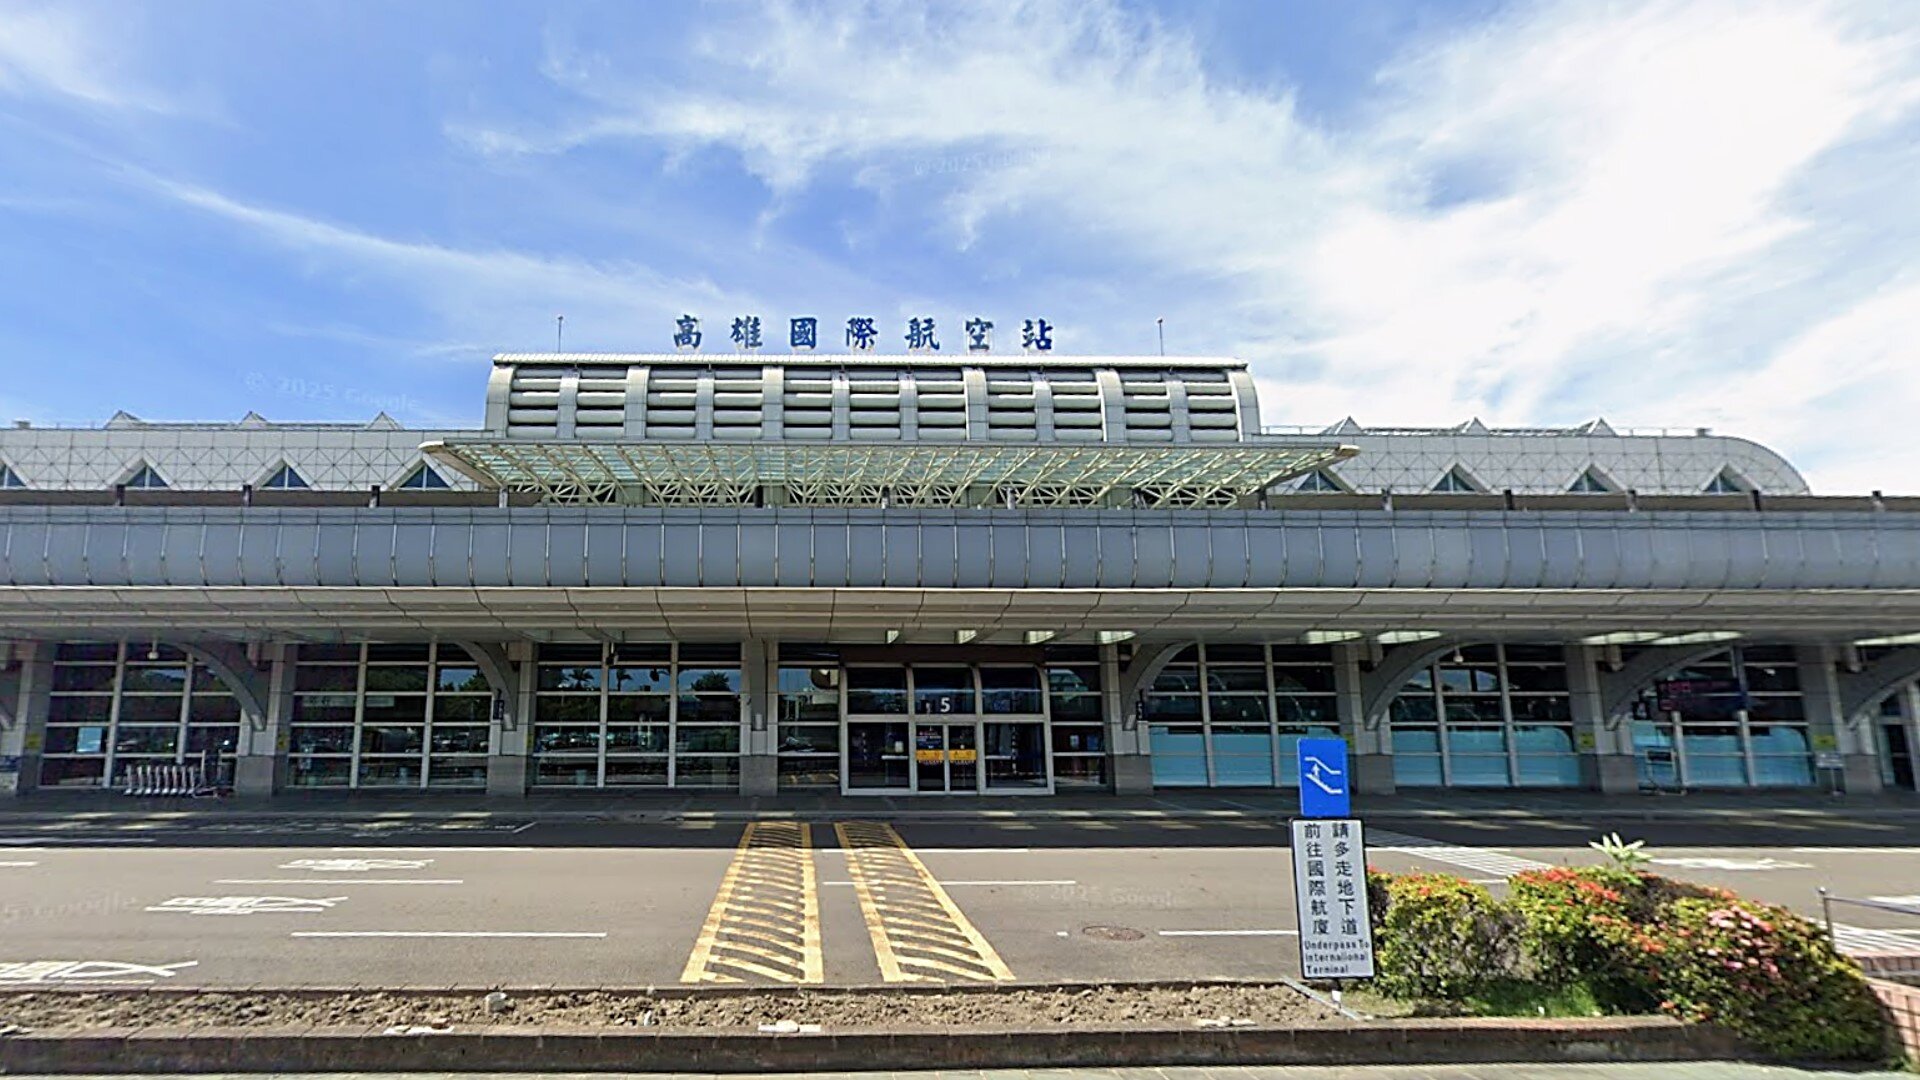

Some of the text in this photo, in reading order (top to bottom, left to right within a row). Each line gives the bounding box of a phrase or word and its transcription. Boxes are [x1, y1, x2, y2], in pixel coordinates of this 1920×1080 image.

[673, 314, 1054, 351] 高雄國際航空站
[940, 696, 951, 713] 5
[1332, 822, 1358, 935] 請多走地下道
[1304, 939, 1370, 951] Underpass To
[1306, 964, 1349, 975] Terminal
